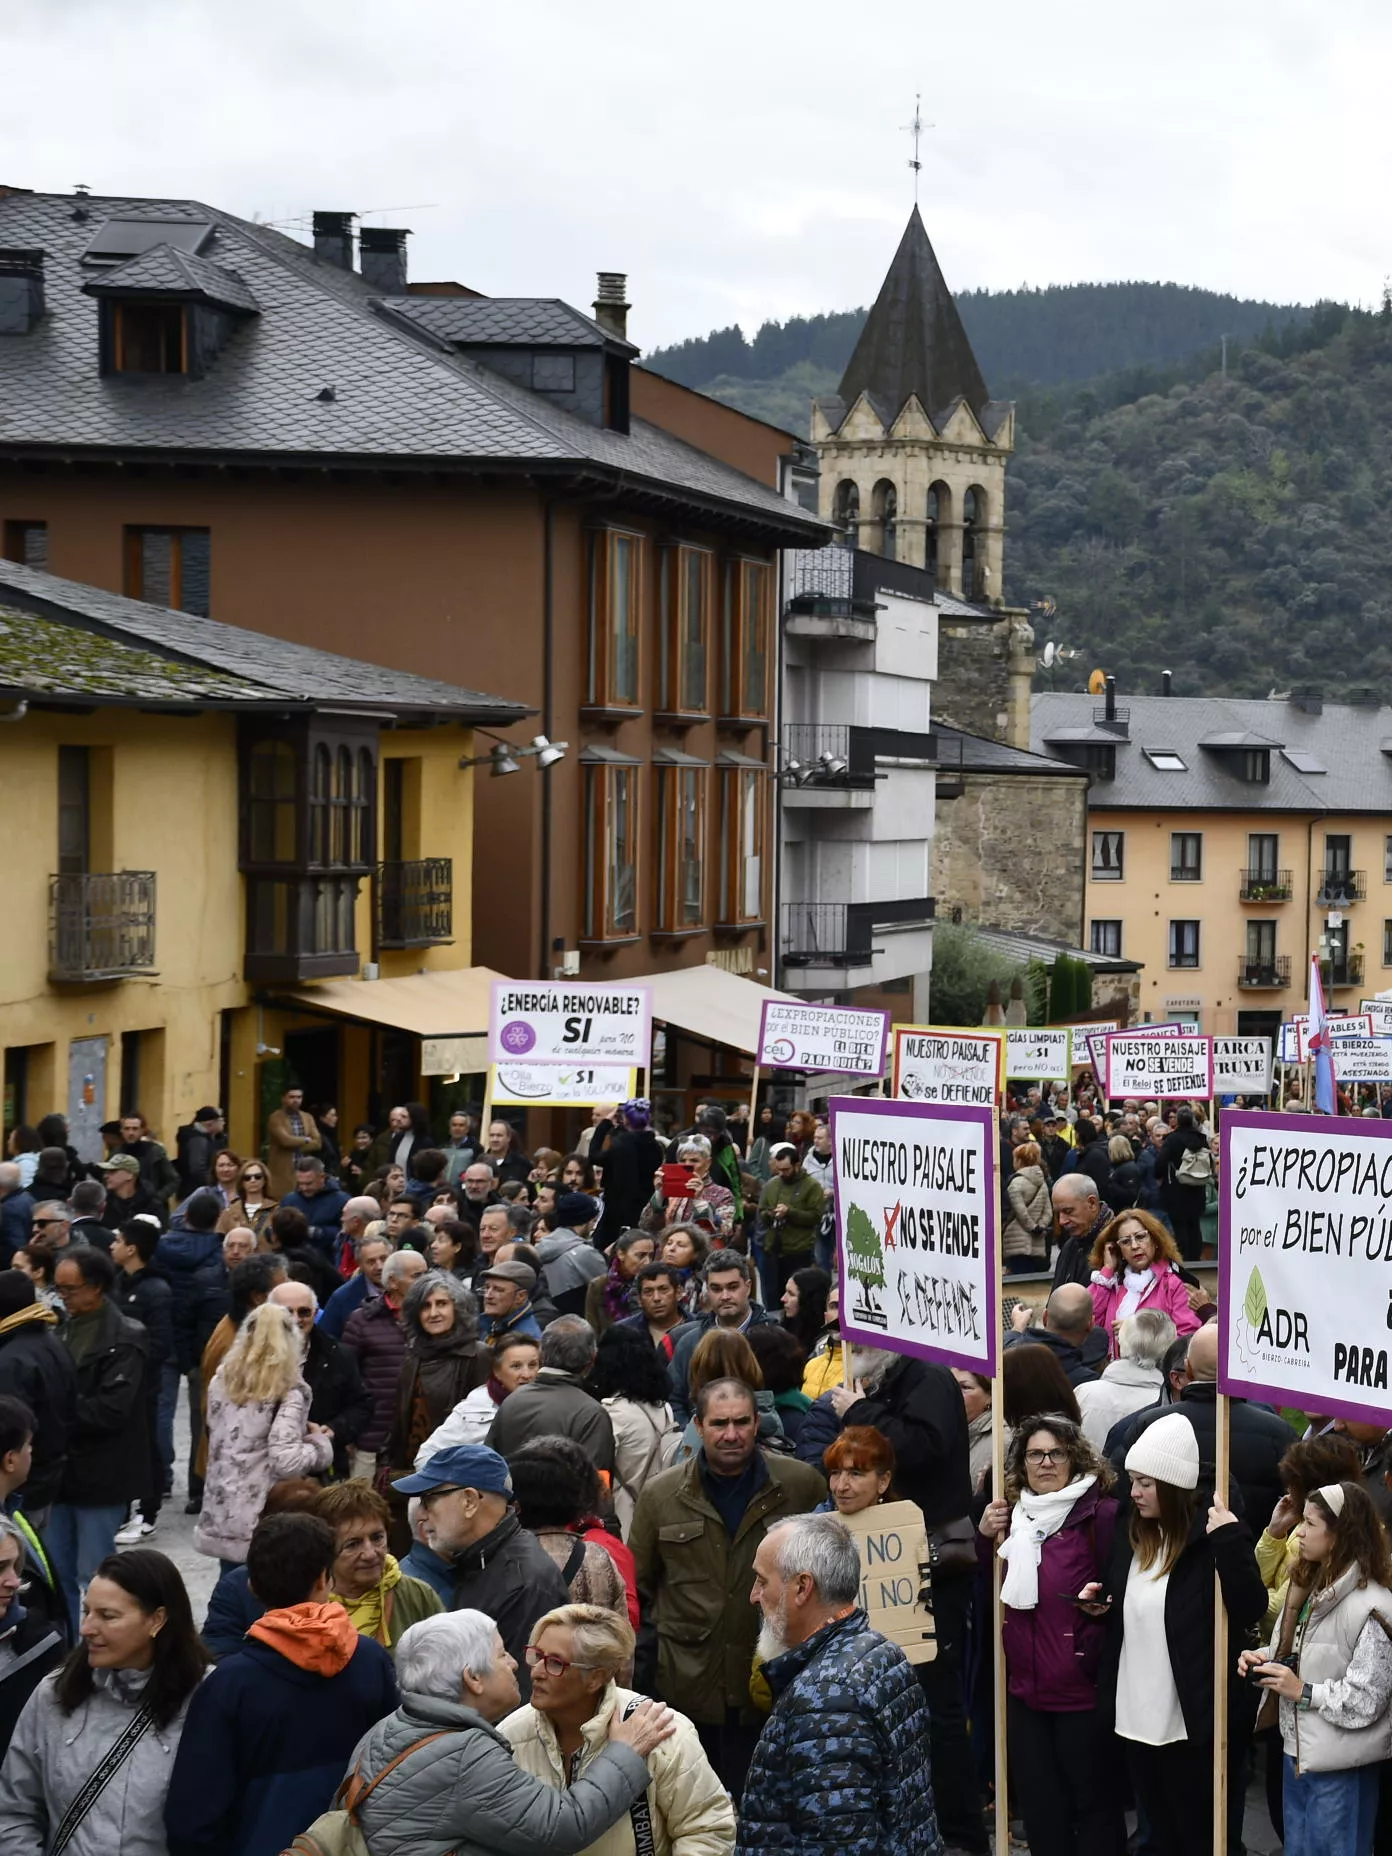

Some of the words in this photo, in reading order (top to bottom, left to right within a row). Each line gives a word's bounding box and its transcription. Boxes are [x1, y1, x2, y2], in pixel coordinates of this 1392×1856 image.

[501, 989, 559, 1015] ¿ENERGÍA
[563, 994, 640, 1015] RENOVABLE?
[562, 1017, 593, 1043] SI
[770, 1007, 881, 1027] ¿EXPROPIACIONES
[790, 1023, 820, 1037] BIEN
[906, 1038, 950, 1060] NUESTRO
[951, 1041, 990, 1063] PAISAJE
[1029, 1033, 1066, 1046] LIMPIAS?
[1112, 1042, 1161, 1056] NUESTRO
[1164, 1042, 1207, 1056] PAISAJE
[575, 1070, 594, 1084] SI
[1034, 1063, 1049, 1073] NO
[1125, 1058, 1146, 1071] NO
[1148, 1057, 1161, 1073] SE
[1161, 1057, 1194, 1073] VENDE
[924, 1085, 938, 1098] se
[941, 1084, 994, 1104] DEFIENDE
[1153, 1079, 1165, 1094] SE
[1166, 1073, 1207, 1092] DEFIENDE
[842, 1137, 908, 1185] NUESTRO
[913, 1144, 977, 1194] PAISAJE
[900, 1206, 917, 1250] NO
[919, 1208, 936, 1252] SE
[936, 1210, 979, 1259] VENDE
[1240, 1227, 1262, 1254] por
[1264, 1223, 1278, 1248] el
[1282, 1208, 1344, 1257] BIEN
[848, 1249, 882, 1276] NOGALÓN
[897, 1268, 916, 1327] SE
[914, 1271, 981, 1341] DEFIENDE
[1256, 1306, 1310, 1353] ADR
[1333, 1342, 1390, 1390] PARA
[866, 1532, 903, 1565] NO
[880, 1577, 914, 1609] NO
